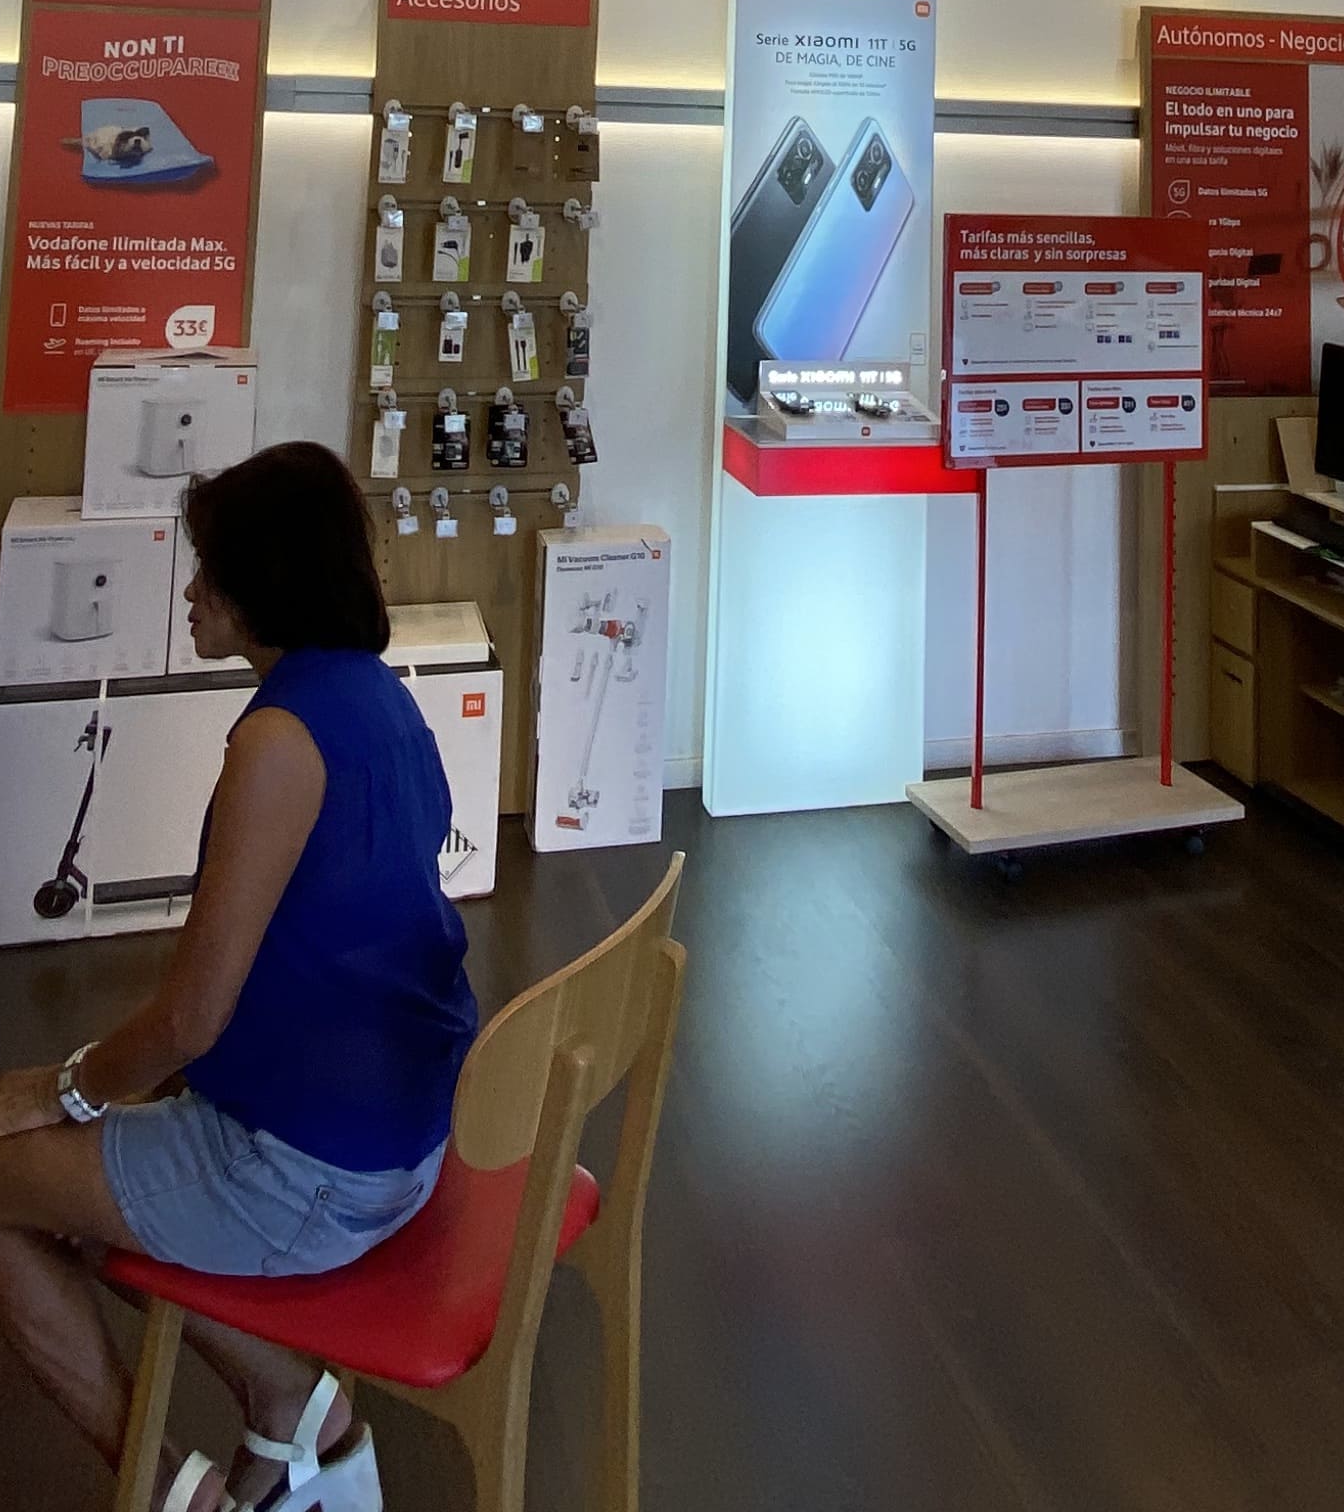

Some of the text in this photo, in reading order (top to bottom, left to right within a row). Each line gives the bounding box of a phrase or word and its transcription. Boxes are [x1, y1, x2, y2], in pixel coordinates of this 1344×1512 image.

[755, 33, 790, 47] Serie
[868, 38, 888, 51] 11T
[899, 39, 917, 52] 5G
[1157, 25, 1265, 49] Autónomos
[103, 36, 185, 59] NON TI
[775, 51, 897, 69] DE MAGIA, DE CINE
[1165, 85, 1204, 96] NEGOCIO
[1165, 101, 1295, 122] El todo en uno para
[1229, 124, 1243, 137] tu
[1246, 124, 1299, 141] negocio
[28, 236, 228, 252] Vodafone Ilimitada Max.
[959, 230, 1096, 246] Tarifas más sencillas,
[959, 246, 1128, 263] más claras y sin sorpresas
[26, 254, 236, 273] Más fácil y a velocidad 5G
[173, 320, 207, 337] 33€
